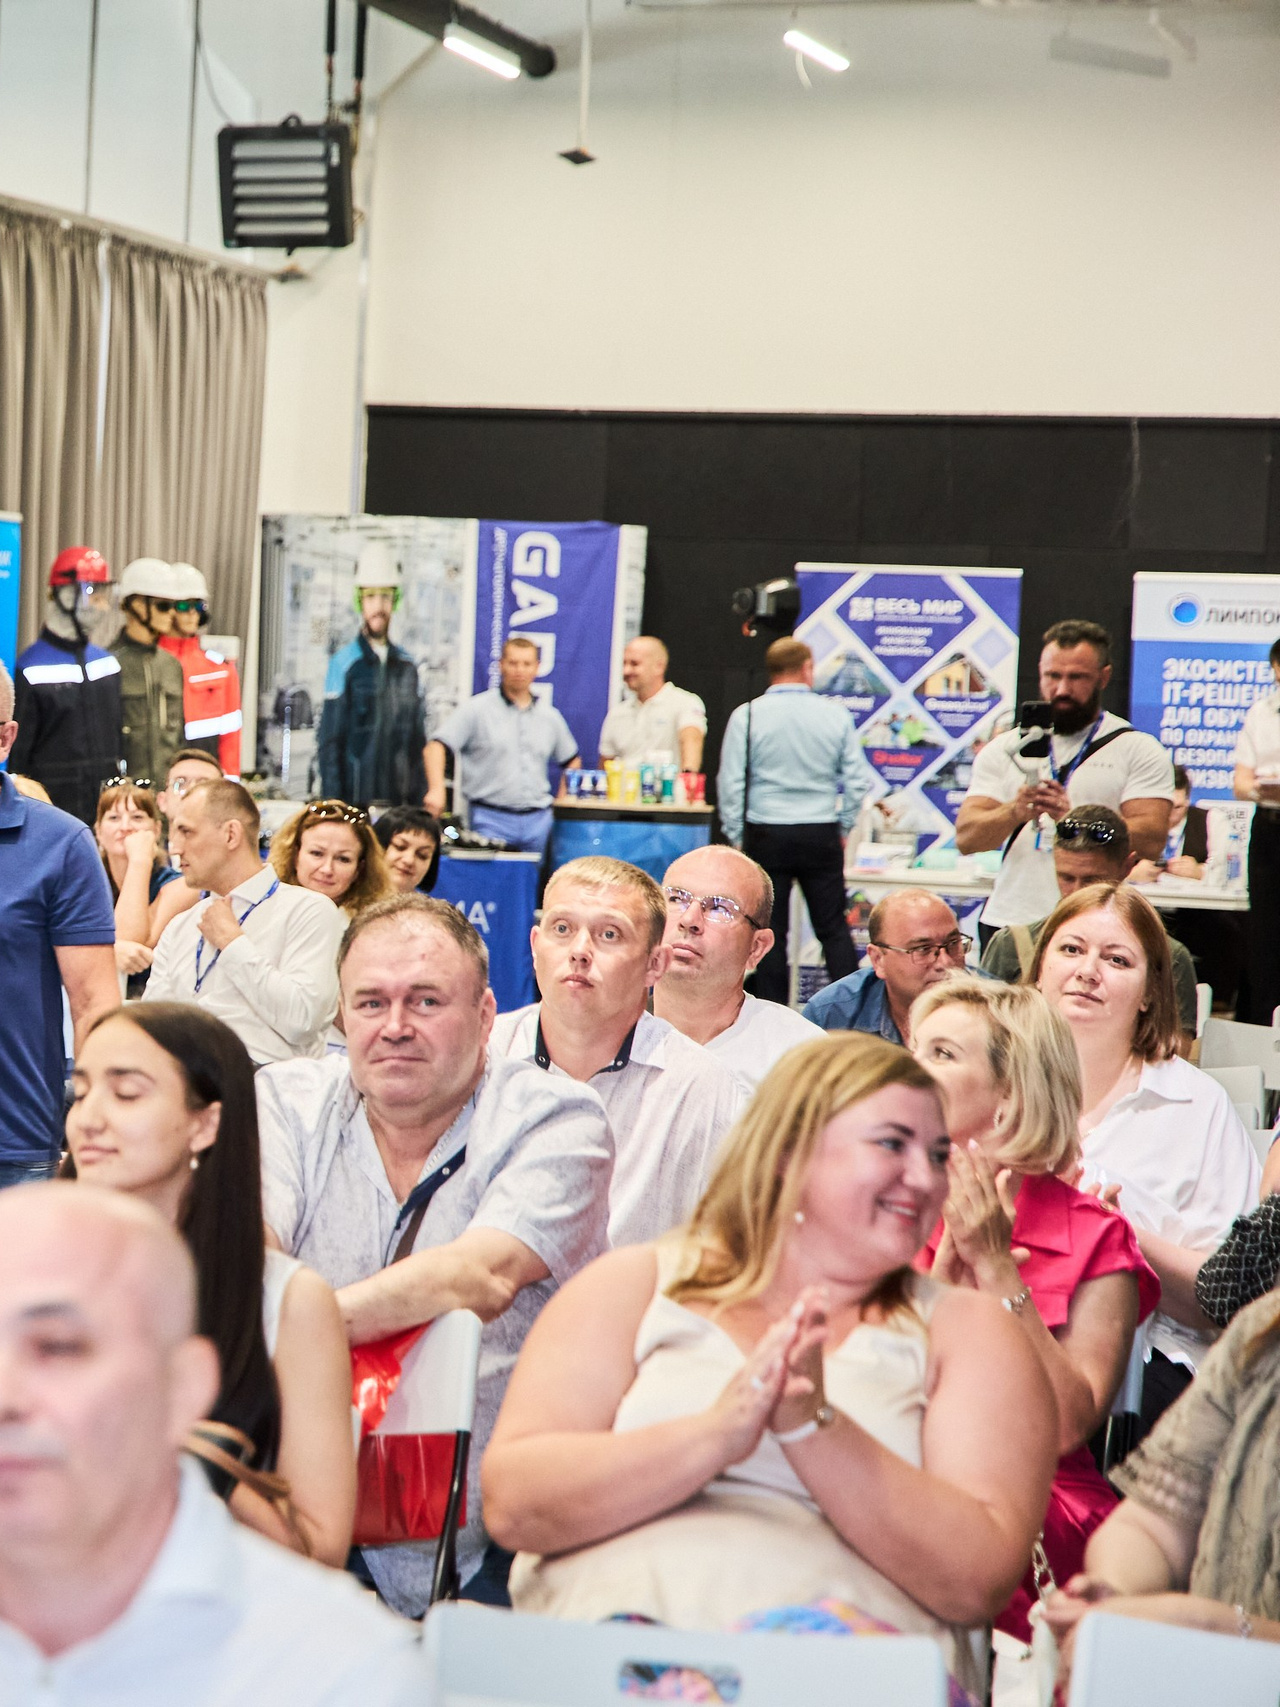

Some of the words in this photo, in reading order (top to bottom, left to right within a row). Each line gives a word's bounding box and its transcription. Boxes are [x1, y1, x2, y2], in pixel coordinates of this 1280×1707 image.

[874, 598, 921, 615] ВЕСЬ
[922, 599, 964, 616] МИР
[1160, 706, 1202, 729] ДЛЯ
[1160, 728, 1184, 746] ПО
[1184, 728, 1240, 748] ОХРАН
